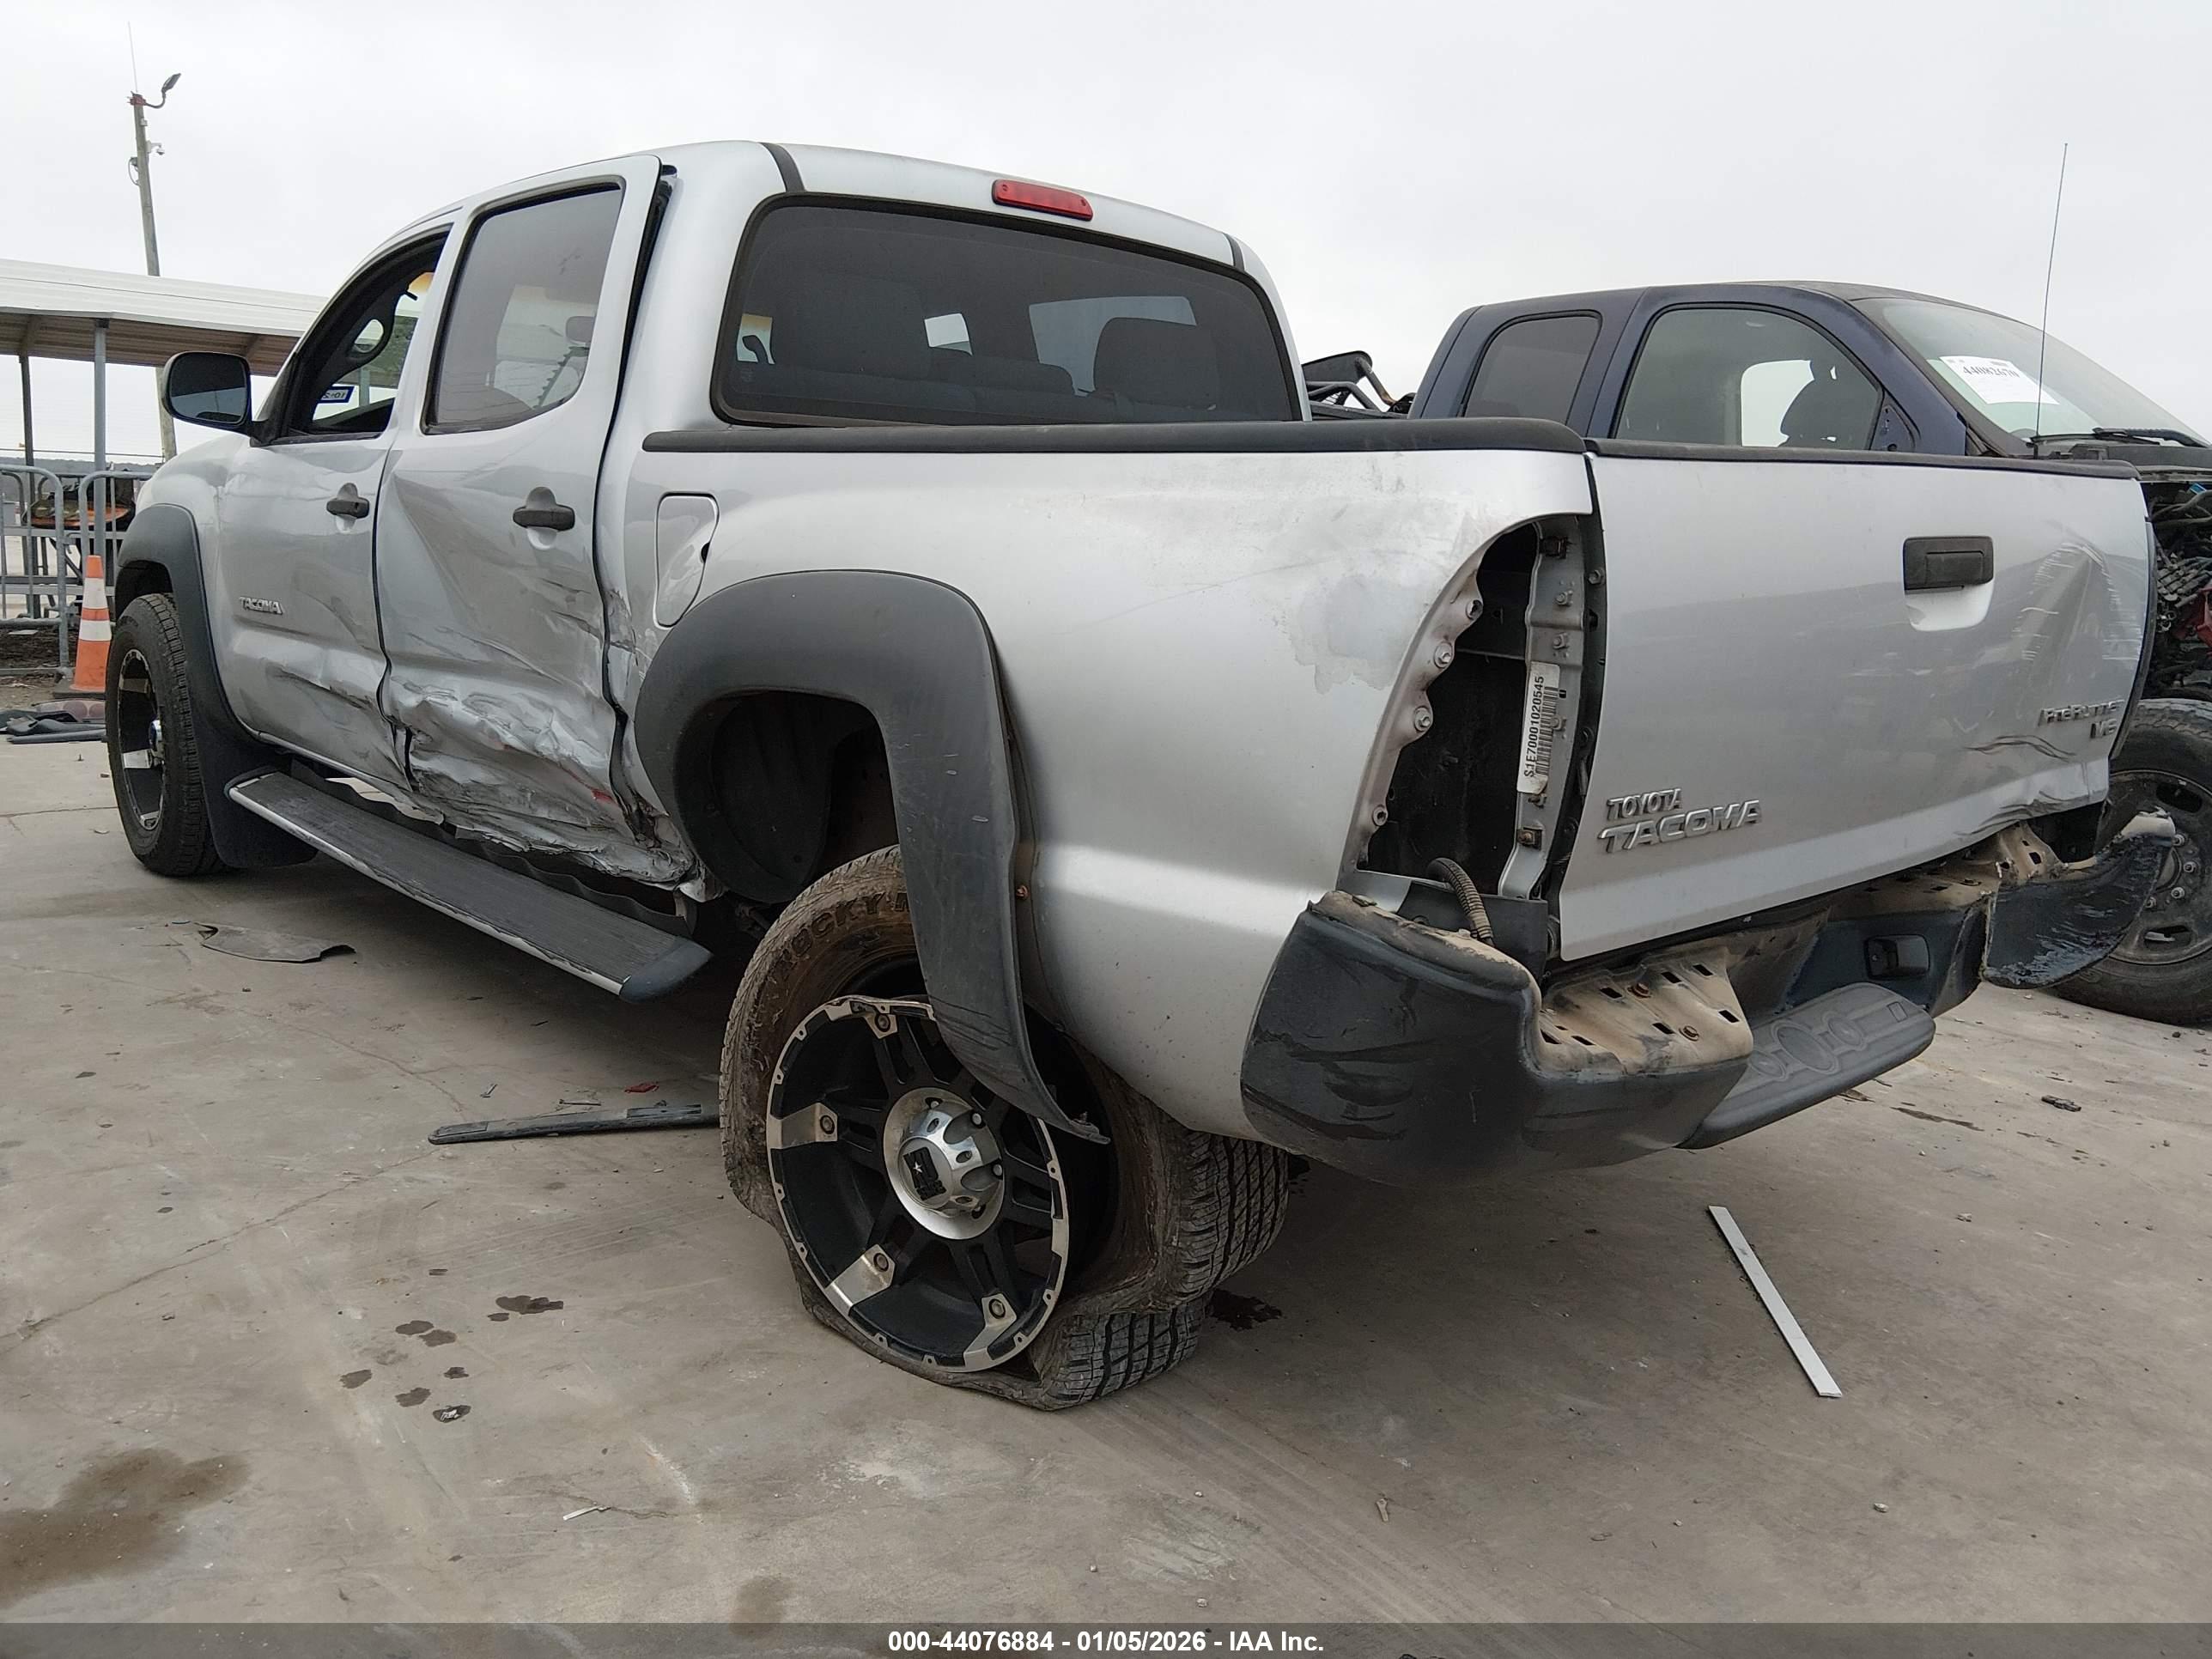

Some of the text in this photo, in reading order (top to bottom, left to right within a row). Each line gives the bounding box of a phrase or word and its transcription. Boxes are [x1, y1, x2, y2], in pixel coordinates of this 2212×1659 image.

[240, 597, 283, 615] TACOMA
[1523, 676, 1545, 777] S1E70001020545
[1607, 787, 1683, 821] TOYOTA
[1597, 799, 1761, 854] TACOMA
